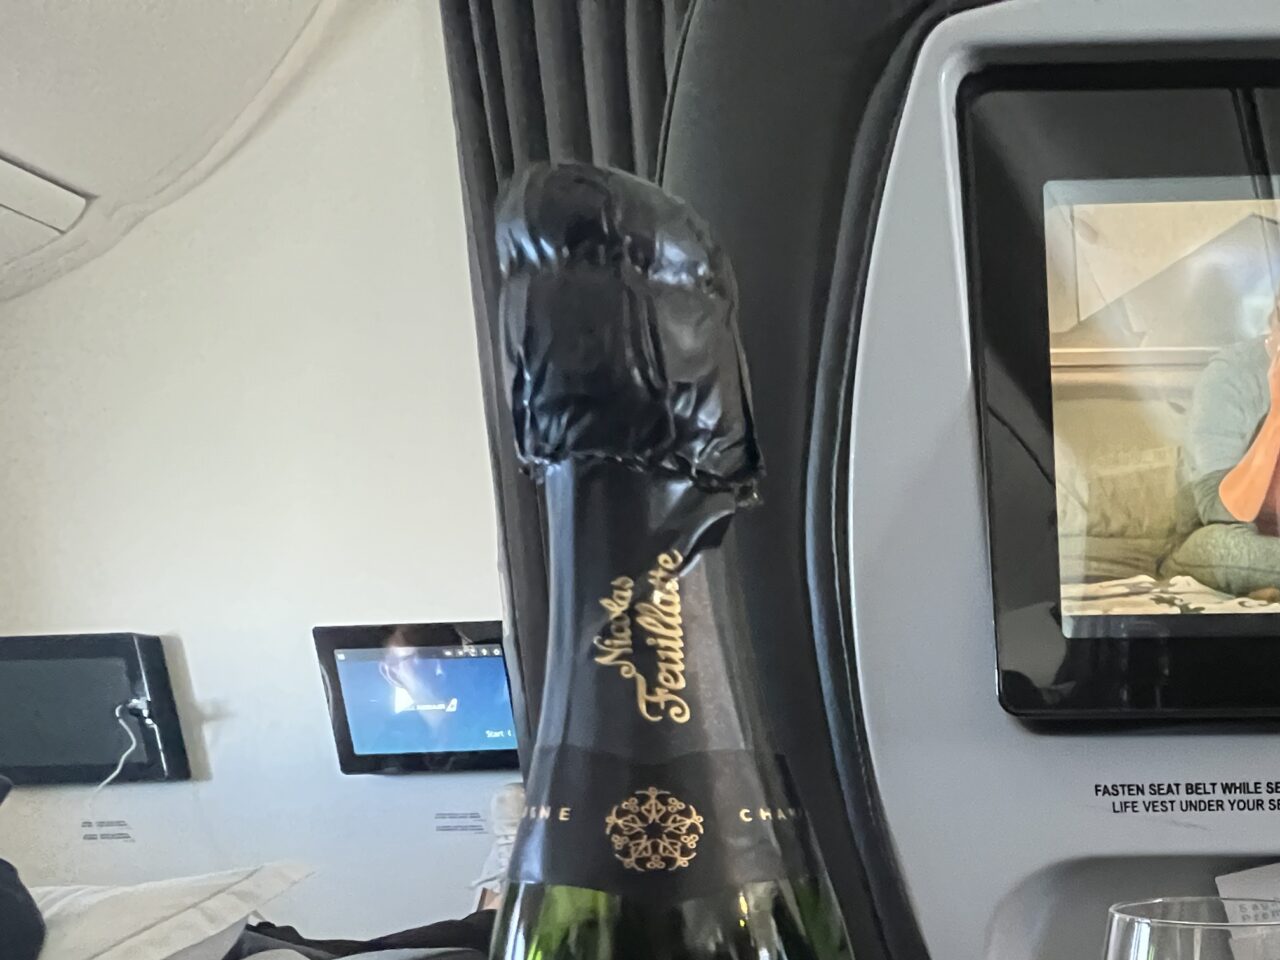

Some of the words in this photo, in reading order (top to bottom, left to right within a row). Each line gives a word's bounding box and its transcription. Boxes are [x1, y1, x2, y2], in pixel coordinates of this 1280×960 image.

[593, 576, 636, 679] Nicolas
[1094, 784, 1145, 797] FASTEN
[1149, 783, 1181, 796] SEAT
[1185, 782, 1218, 795] BELT
[1221, 781, 1262, 795] WHILE
[1112, 800, 1139, 813] LIFE
[1142, 800, 1176, 813] VEST
[1180, 799, 1225, 812] UNDER
[1228, 798, 1265, 811] YOUR
